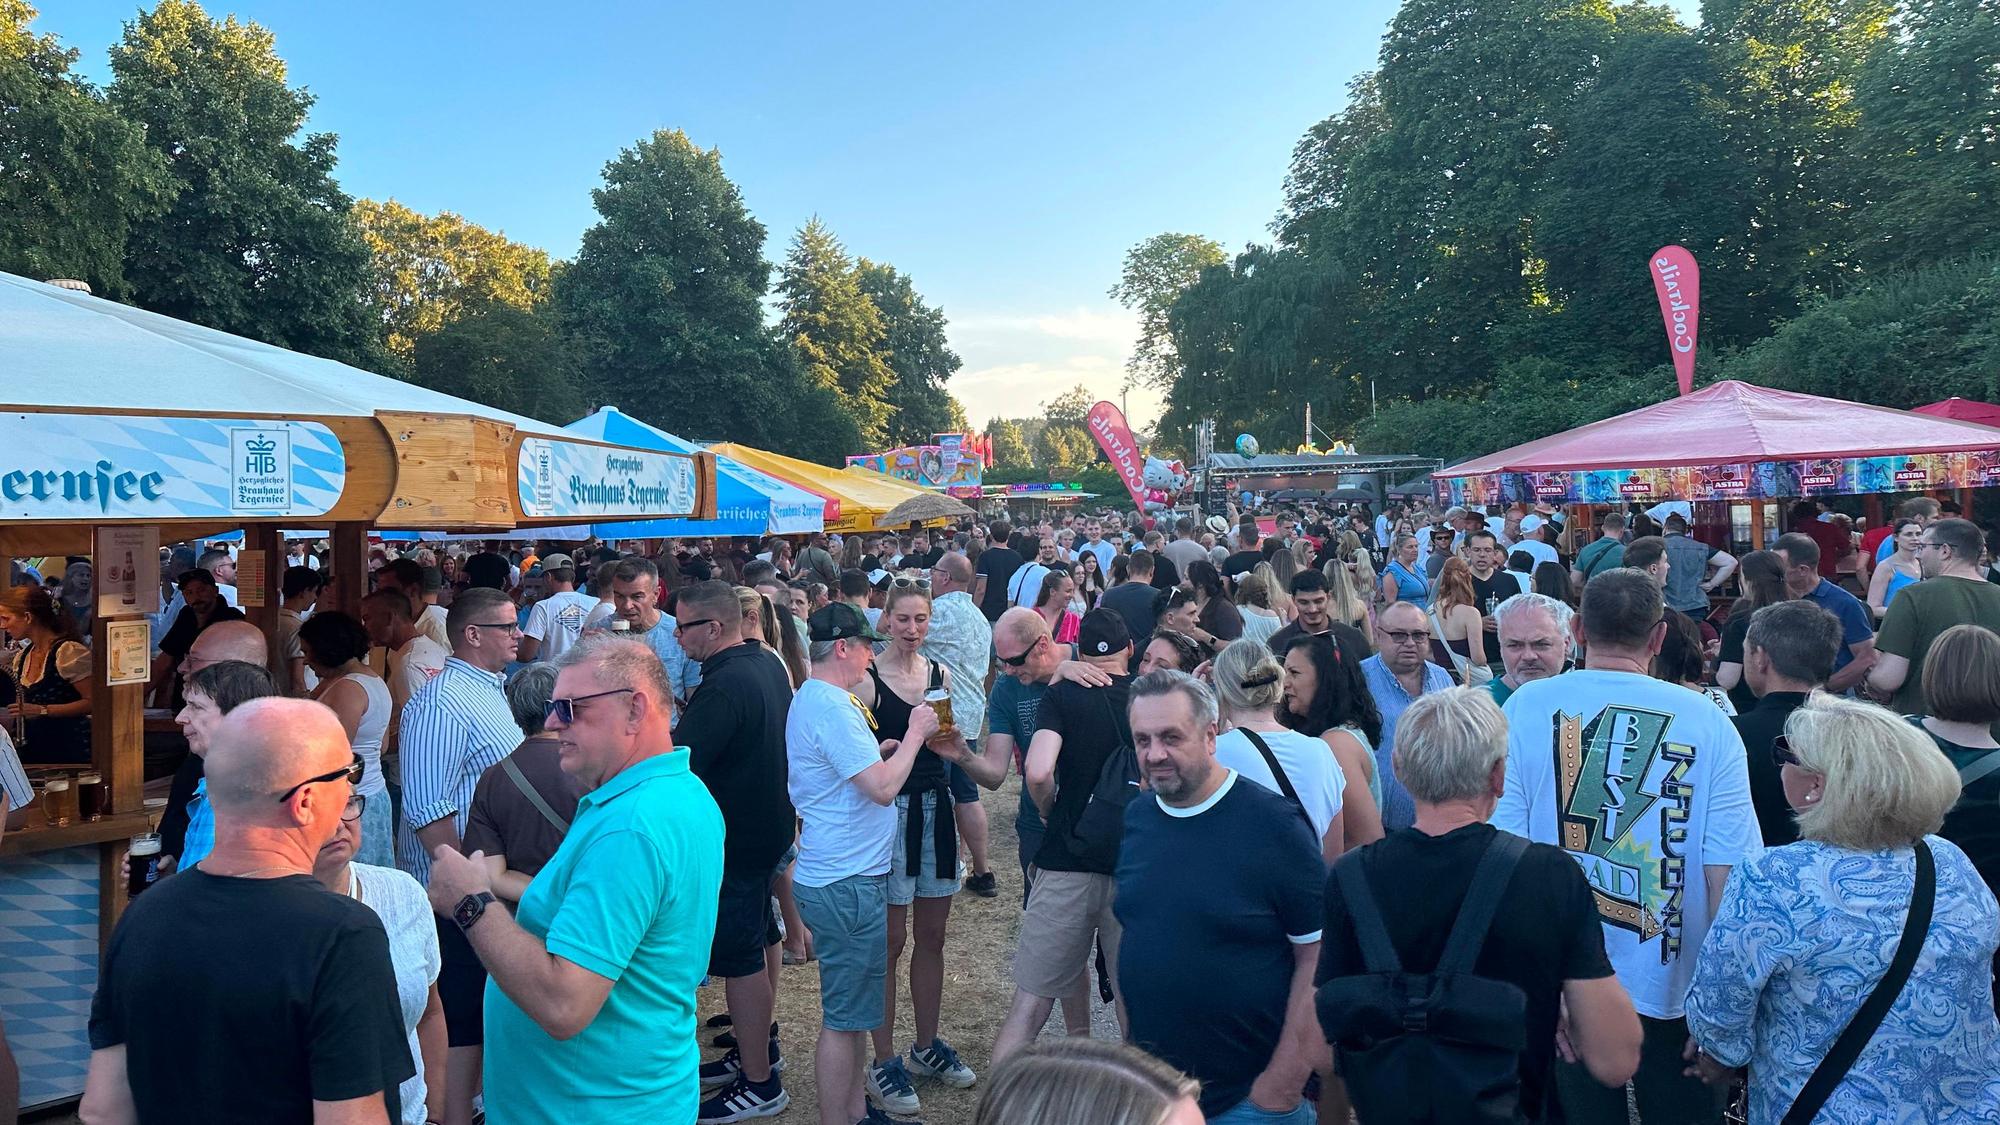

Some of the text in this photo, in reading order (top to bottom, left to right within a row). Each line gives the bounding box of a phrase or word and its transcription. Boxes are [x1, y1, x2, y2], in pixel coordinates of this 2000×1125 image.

[606, 453, 644, 475] Herzogliches
[238, 476, 285, 485] Herzogliches
[1803, 476, 1832, 484] ASTRA
[1896, 472, 1926, 480] ASTRA
[238, 485, 285, 496] Brauhaus
[569, 475, 626, 512] Brauhaus
[627, 477, 670, 512] Tegernsee
[1536, 486, 1563, 494] ASTRA
[238, 494, 285, 505] Tegernsee
[1602, 712, 1641, 840] BEST
[1661, 741, 1696, 965] INFLUENCE
